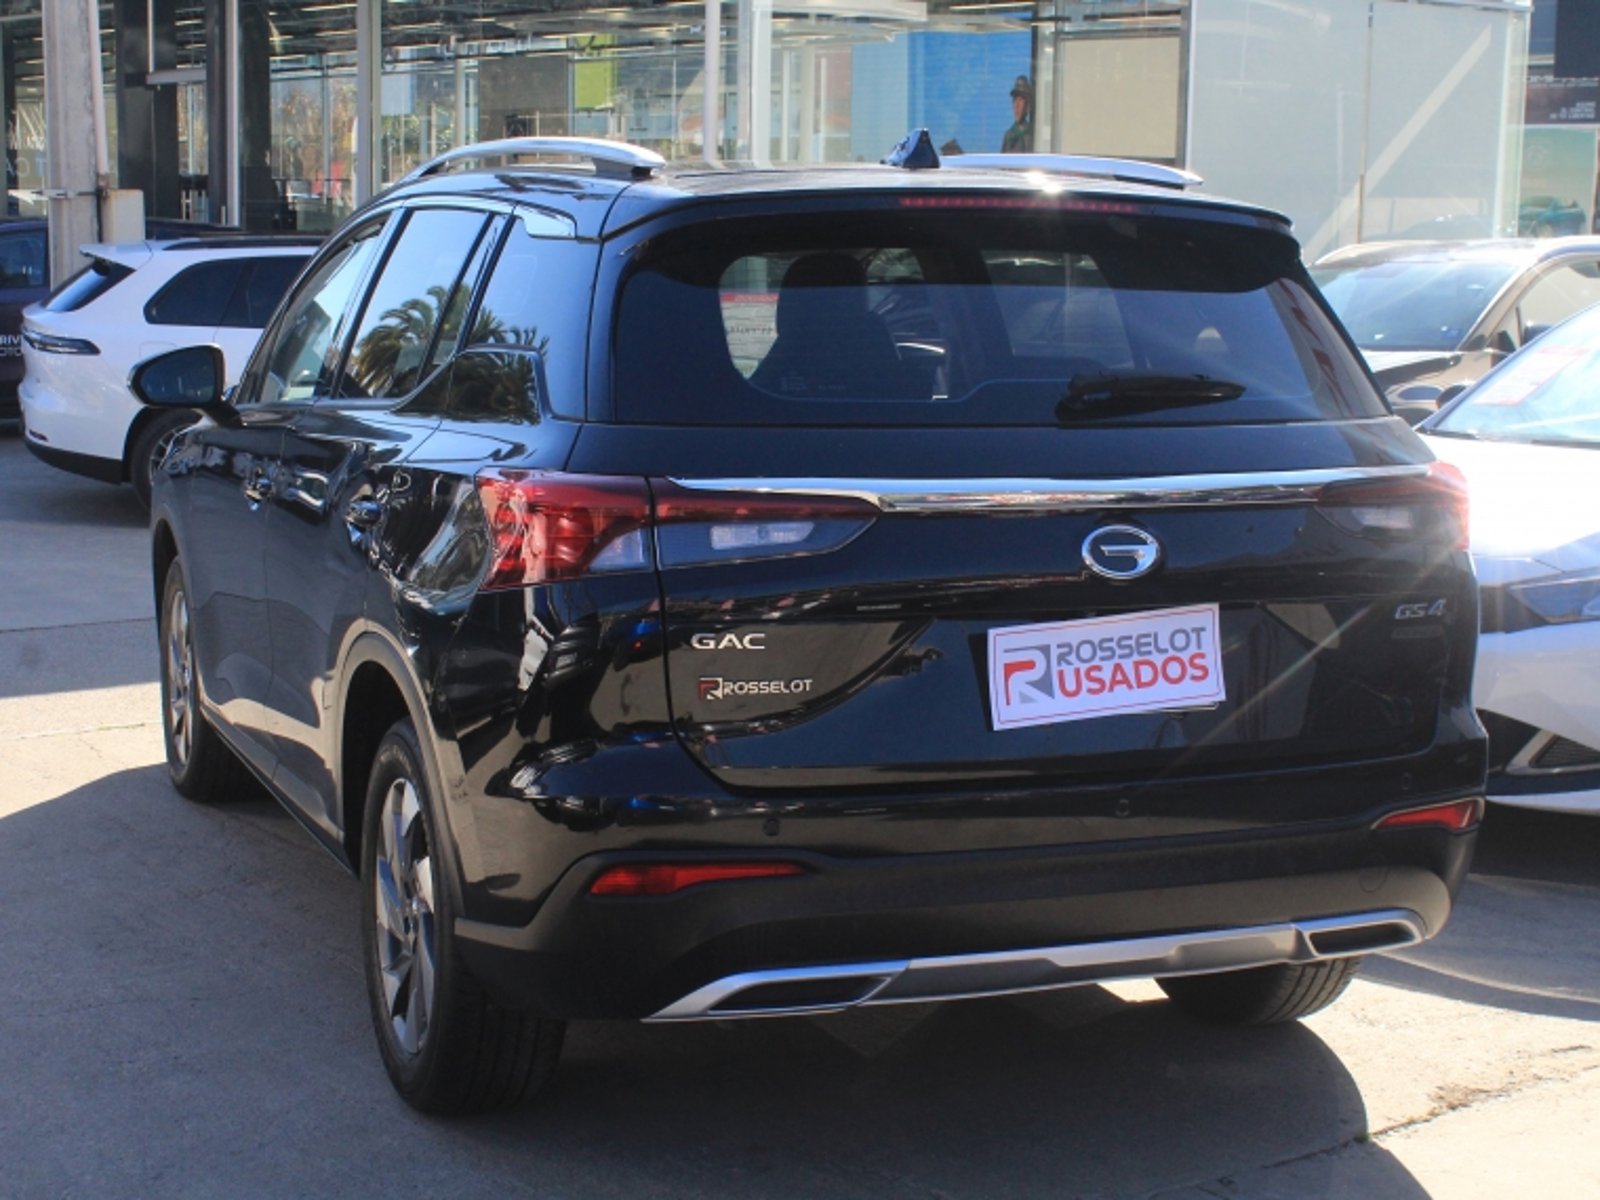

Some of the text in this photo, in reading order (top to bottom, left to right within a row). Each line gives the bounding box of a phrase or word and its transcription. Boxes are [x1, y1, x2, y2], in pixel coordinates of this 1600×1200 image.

[1394, 597, 1448, 620] GS4
[690, 632, 766, 650] GAC
[1056, 626, 1207, 667] ROSSELOT
[1056, 651, 1211, 699] USADOS
[723, 678, 813, 696] ROSSELOT
